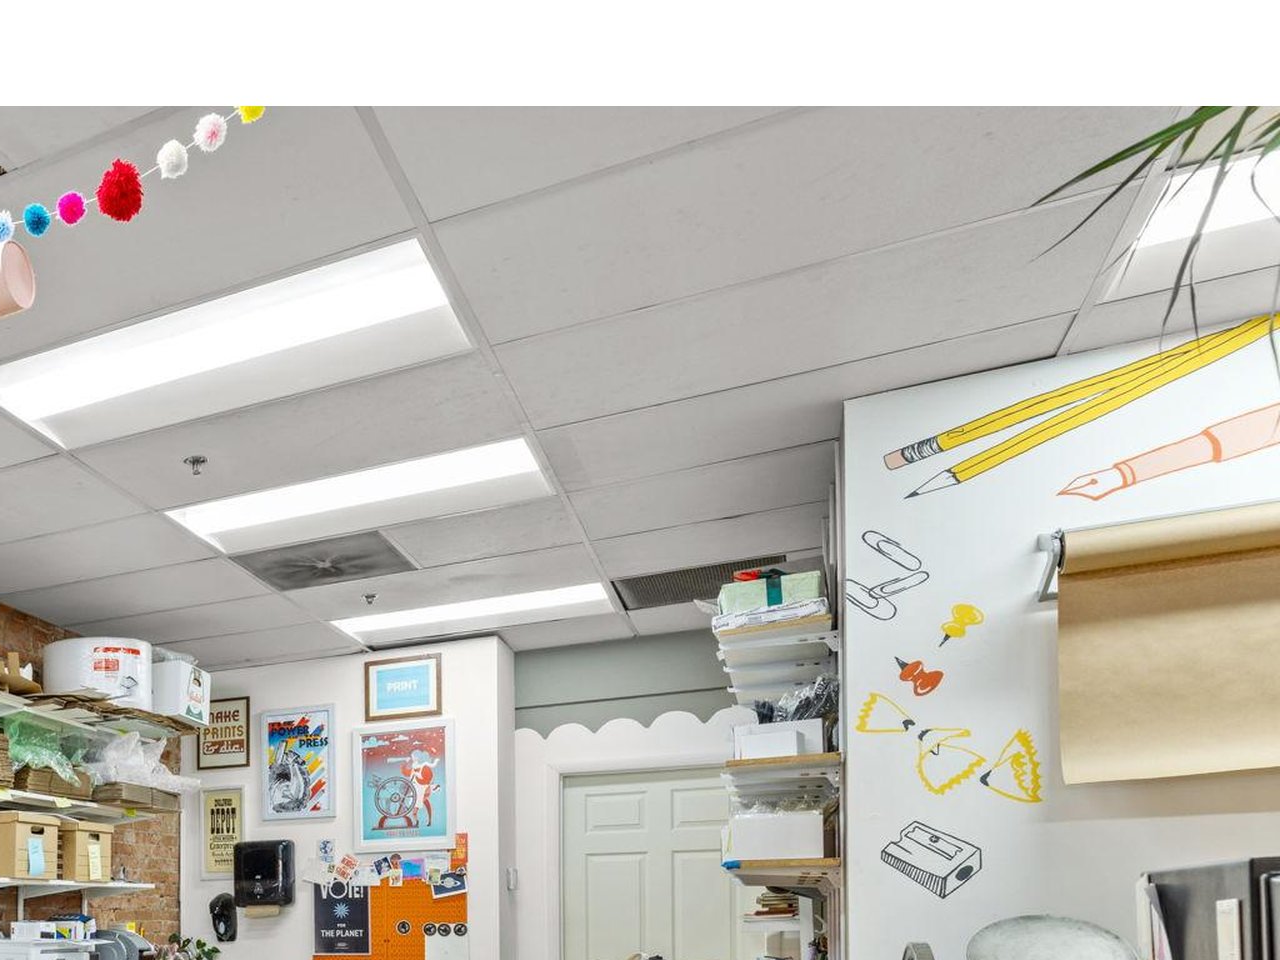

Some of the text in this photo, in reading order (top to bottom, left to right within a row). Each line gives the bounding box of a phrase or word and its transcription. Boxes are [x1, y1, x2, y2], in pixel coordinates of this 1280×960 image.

[386, 680, 418, 693] PRINT
[203, 725, 244, 740] PRINTS
[299, 737, 328, 748] PRESS
[210, 808, 236, 834] DEPOT
[320, 929, 364, 938] THE PLANET
